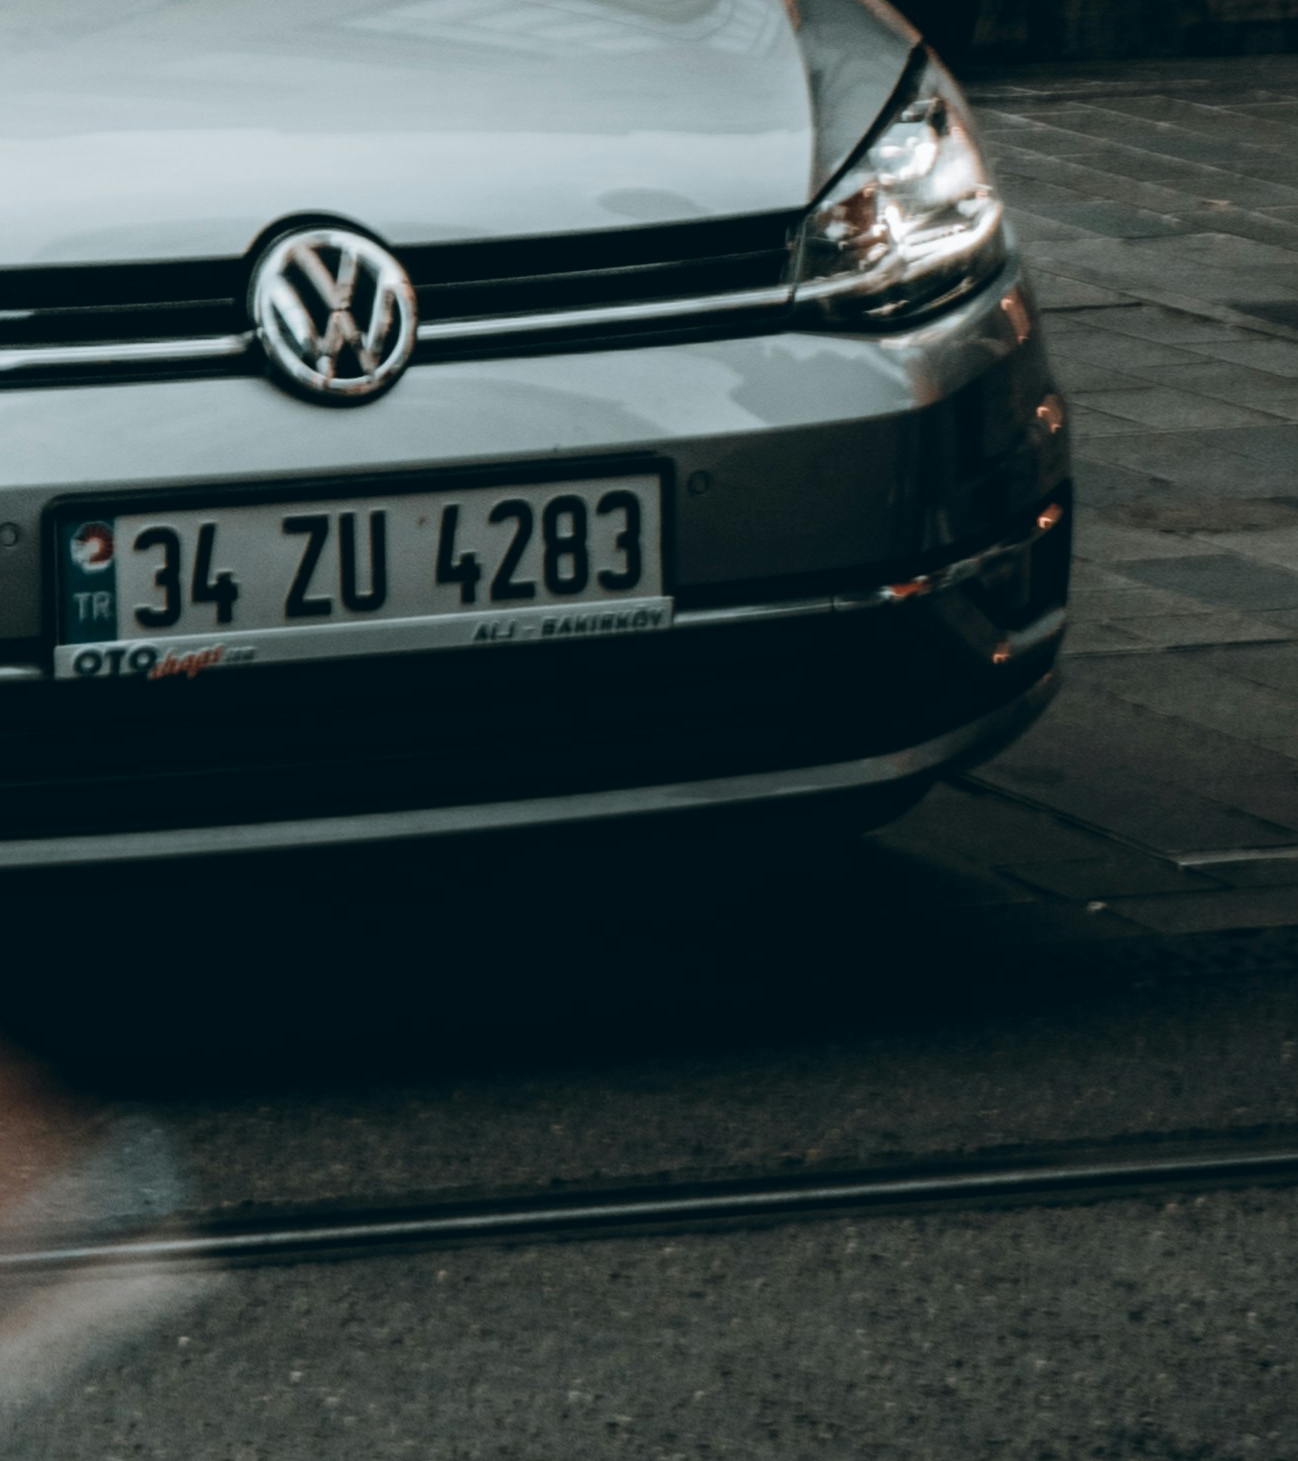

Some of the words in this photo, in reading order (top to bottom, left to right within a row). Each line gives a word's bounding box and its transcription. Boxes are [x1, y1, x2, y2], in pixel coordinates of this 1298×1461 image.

[133, 521, 239, 628] 34
[281, 509, 389, 618] ZU
[435, 489, 643, 604] 4283
[73, 591, 113, 622] TR
